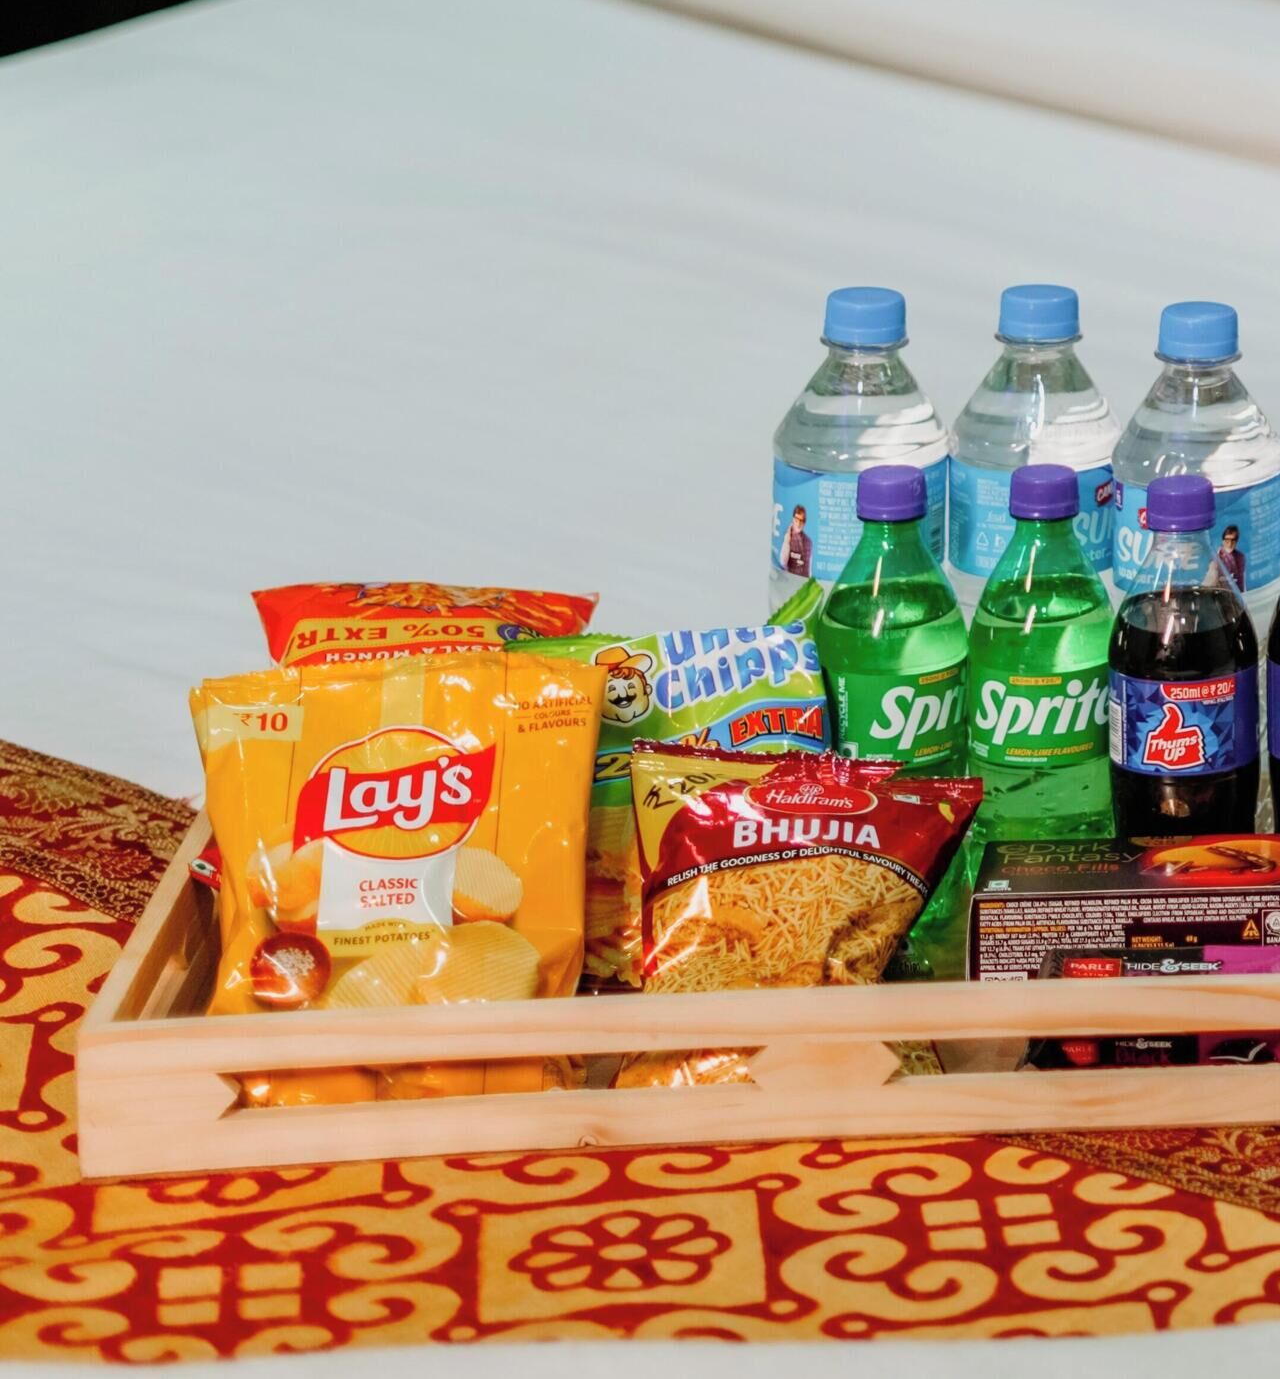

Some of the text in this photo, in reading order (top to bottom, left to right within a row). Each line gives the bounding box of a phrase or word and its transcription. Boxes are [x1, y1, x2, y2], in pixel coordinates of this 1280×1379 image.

[402, 623, 486, 639] 50%
[325, 648, 411, 663] MUNCH
[1170, 687, 1200, 700] 250ml
[517, 717, 587, 734] & FLAVOURS
[729, 707, 824, 746] EXTRA
[1150, 734, 1198, 753] Thums
[323, 756, 473, 832] Lay's
[765, 788, 854, 809] Haldiram's
[733, 818, 881, 849] BHUJIA
[667, 868, 699, 887] RELISH
[699, 862, 719, 875] THE
[720, 852, 780, 868] GOODNESS
[782, 849, 797, 859] OF
[800, 845, 861, 859] DELIGHTFUL
[862, 852, 905, 876] SAVOURY
[359, 877, 418, 893] CLASSIC
[360, 892, 415, 909] SALTED
[333, 935, 370, 946] FINEST
[1070, 962, 1114, 972] PARLE
